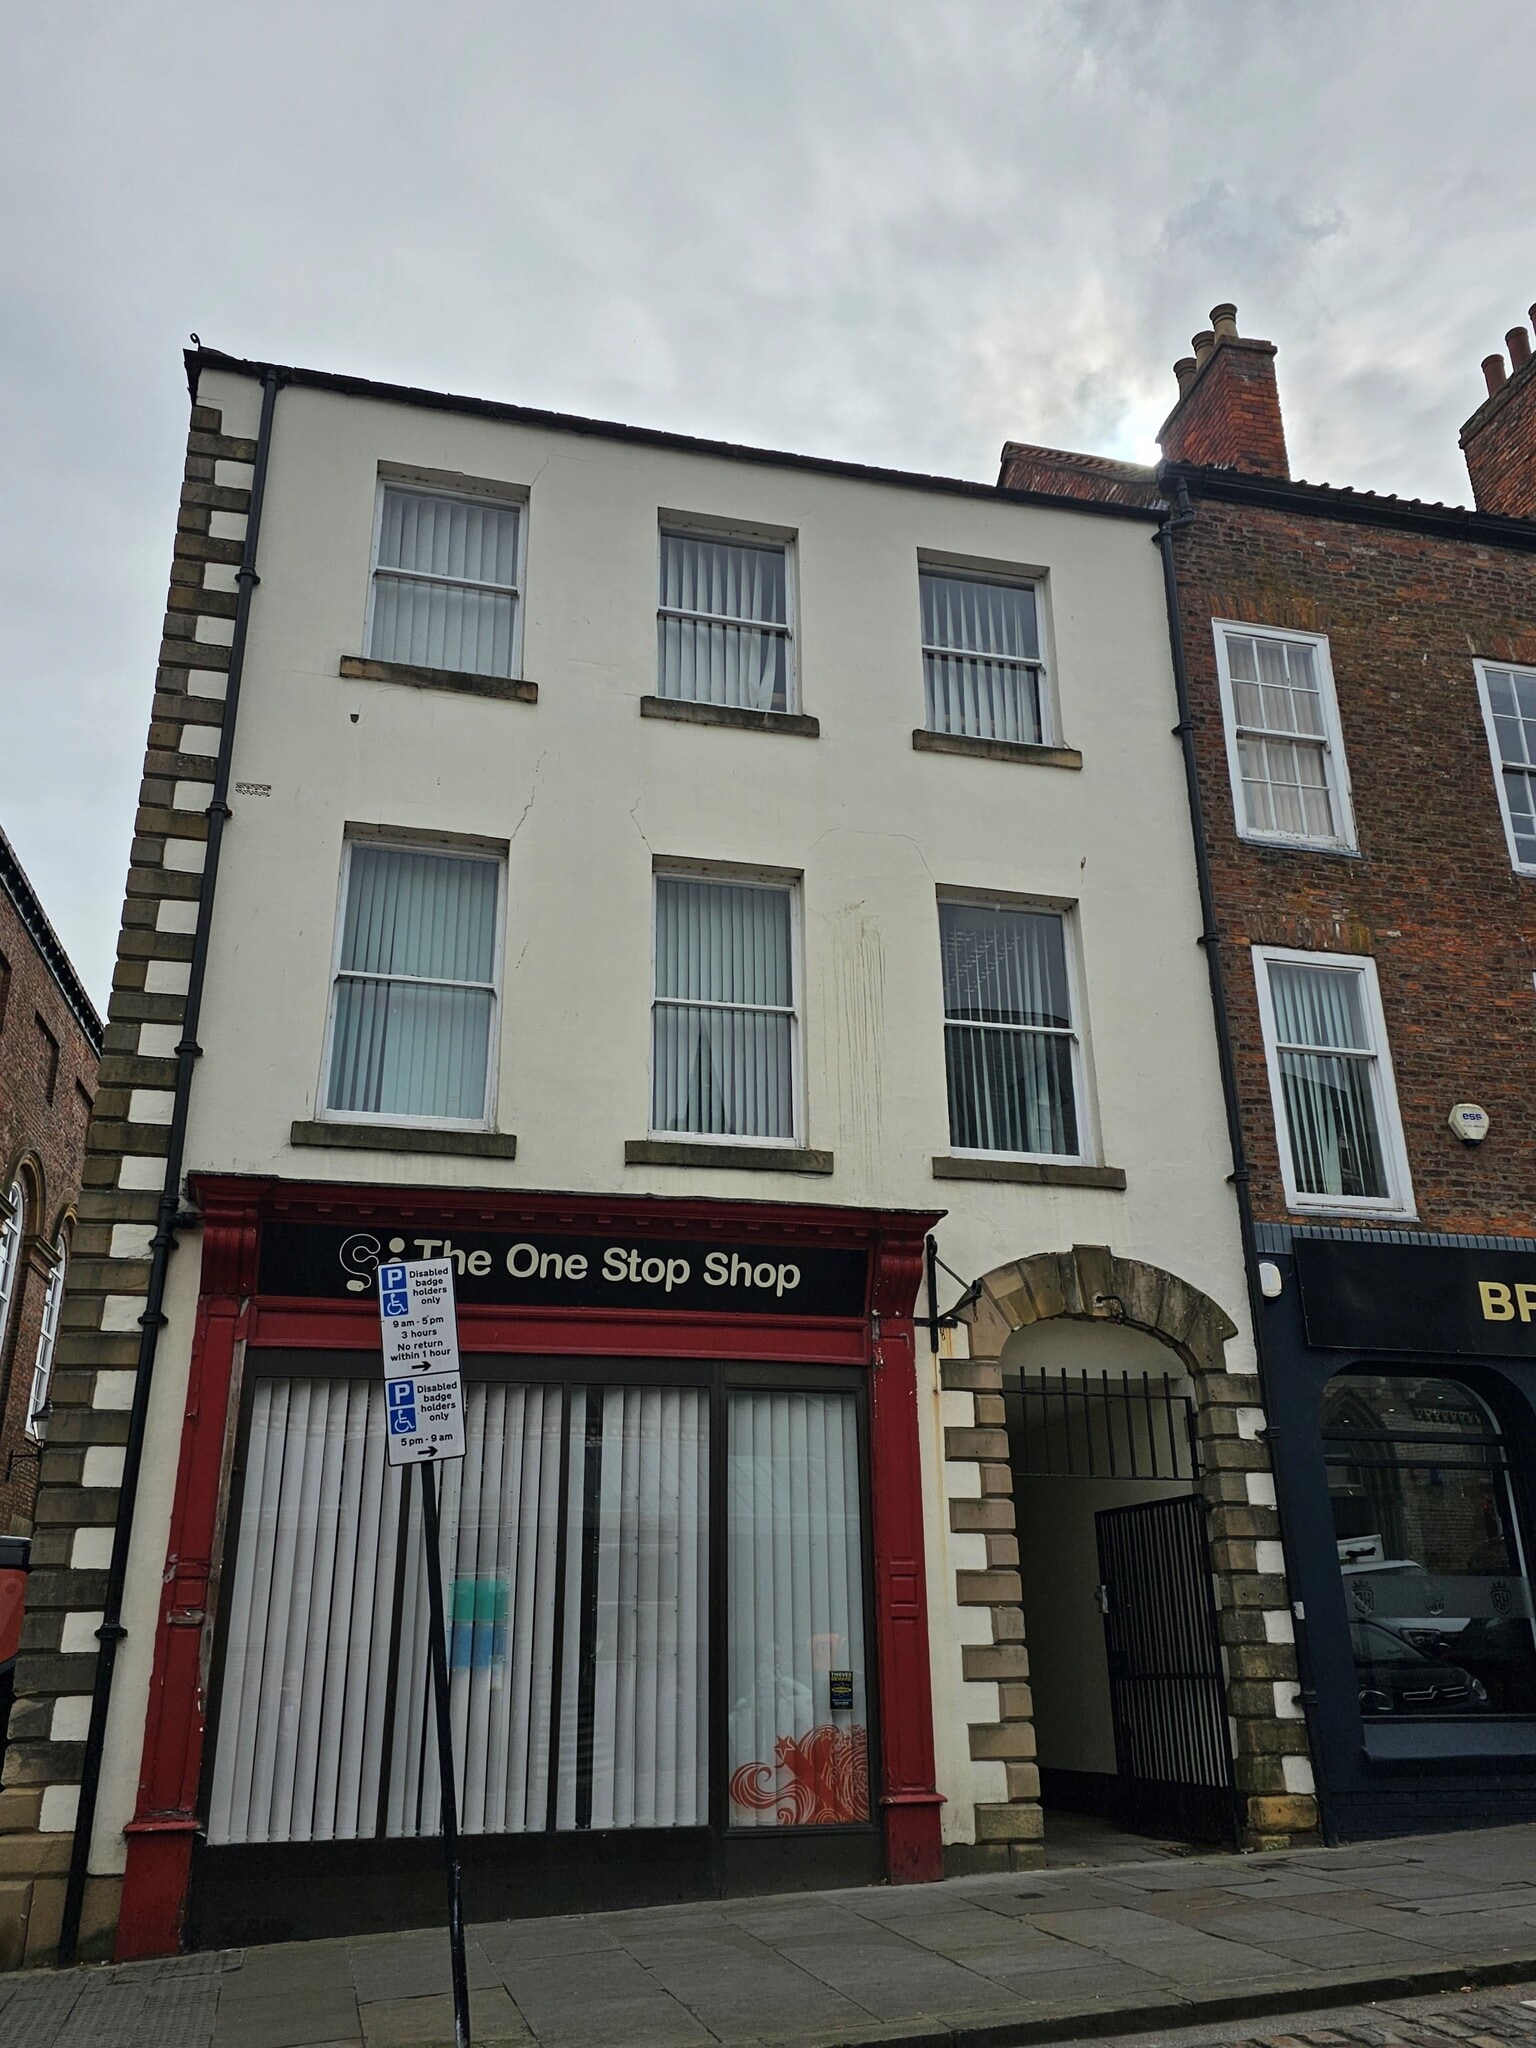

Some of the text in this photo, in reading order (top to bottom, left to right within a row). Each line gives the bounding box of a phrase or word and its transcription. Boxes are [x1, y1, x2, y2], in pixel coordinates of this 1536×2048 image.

[409, 1267, 449, 1279] Disabled
[413, 1239, 801, 1297] The One Stop Shop
[387, 1269, 403, 1288] P
[415, 1278, 444, 1287] badge
[412, 1287, 448, 1296] holders
[420, 1296, 441, 1305] only
[401, 1329, 438, 1339] 3 hours
[397, 1340, 443, 1352] No return
[390, 1348, 451, 1362] within 1 hour
[416, 1381, 458, 1394] Disabled
[394, 1383, 411, 1405] P
[423, 1393, 453, 1403] badge
[420, 1402, 457, 1413] holders
[429, 1412, 450, 1422] only
